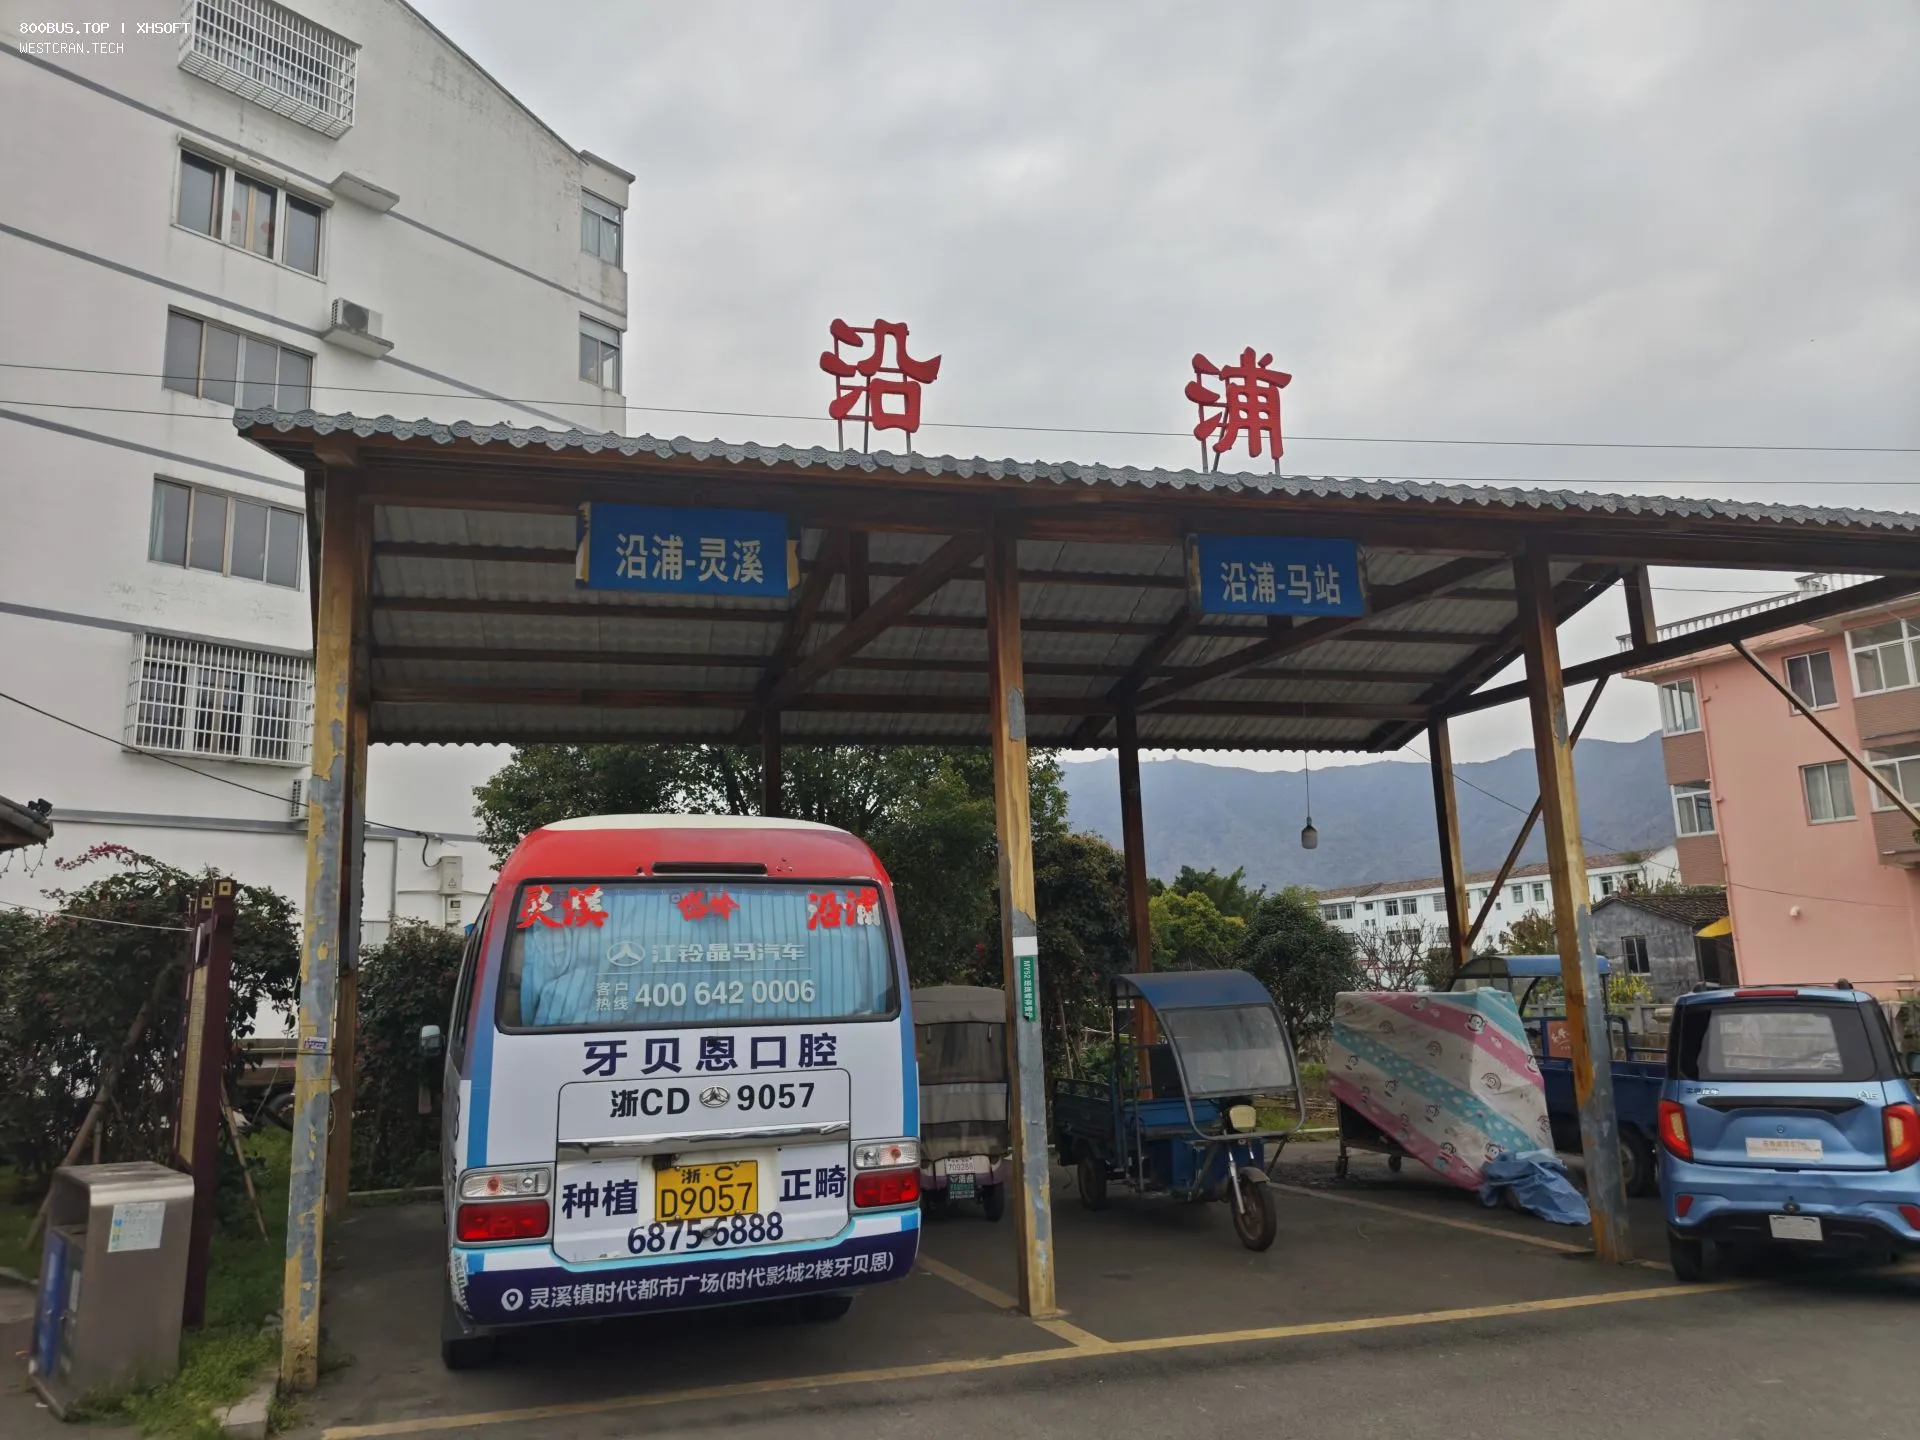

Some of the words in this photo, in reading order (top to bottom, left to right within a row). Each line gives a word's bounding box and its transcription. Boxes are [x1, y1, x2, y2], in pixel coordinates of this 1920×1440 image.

[615, 531, 765, 586] 沿浦-灵溪
[1220, 561, 1341, 607] 沿浦-马站
[651, 942, 807, 964] 江铃晶马汽车
[595, 996, 629, 1011] 热线
[596, 981, 629, 996] 客户
[635, 982, 687, 1007] 400
[694, 981, 744, 1006] 642
[752, 979, 816, 1004] 0006
[582, 1033, 839, 1077] 牙贝恩口腔
[610, 1087, 690, 1118] 浙CD
[737, 1082, 815, 1112] 9057
[561, 1179, 639, 1220] 种植
[661, 1182, 753, 1218] D9057
[779, 1164, 847, 1203] 正畸
[529, 1251, 895, 1311] 灵溪镇时代都市广场(时代影城2楼牙贝恩)
